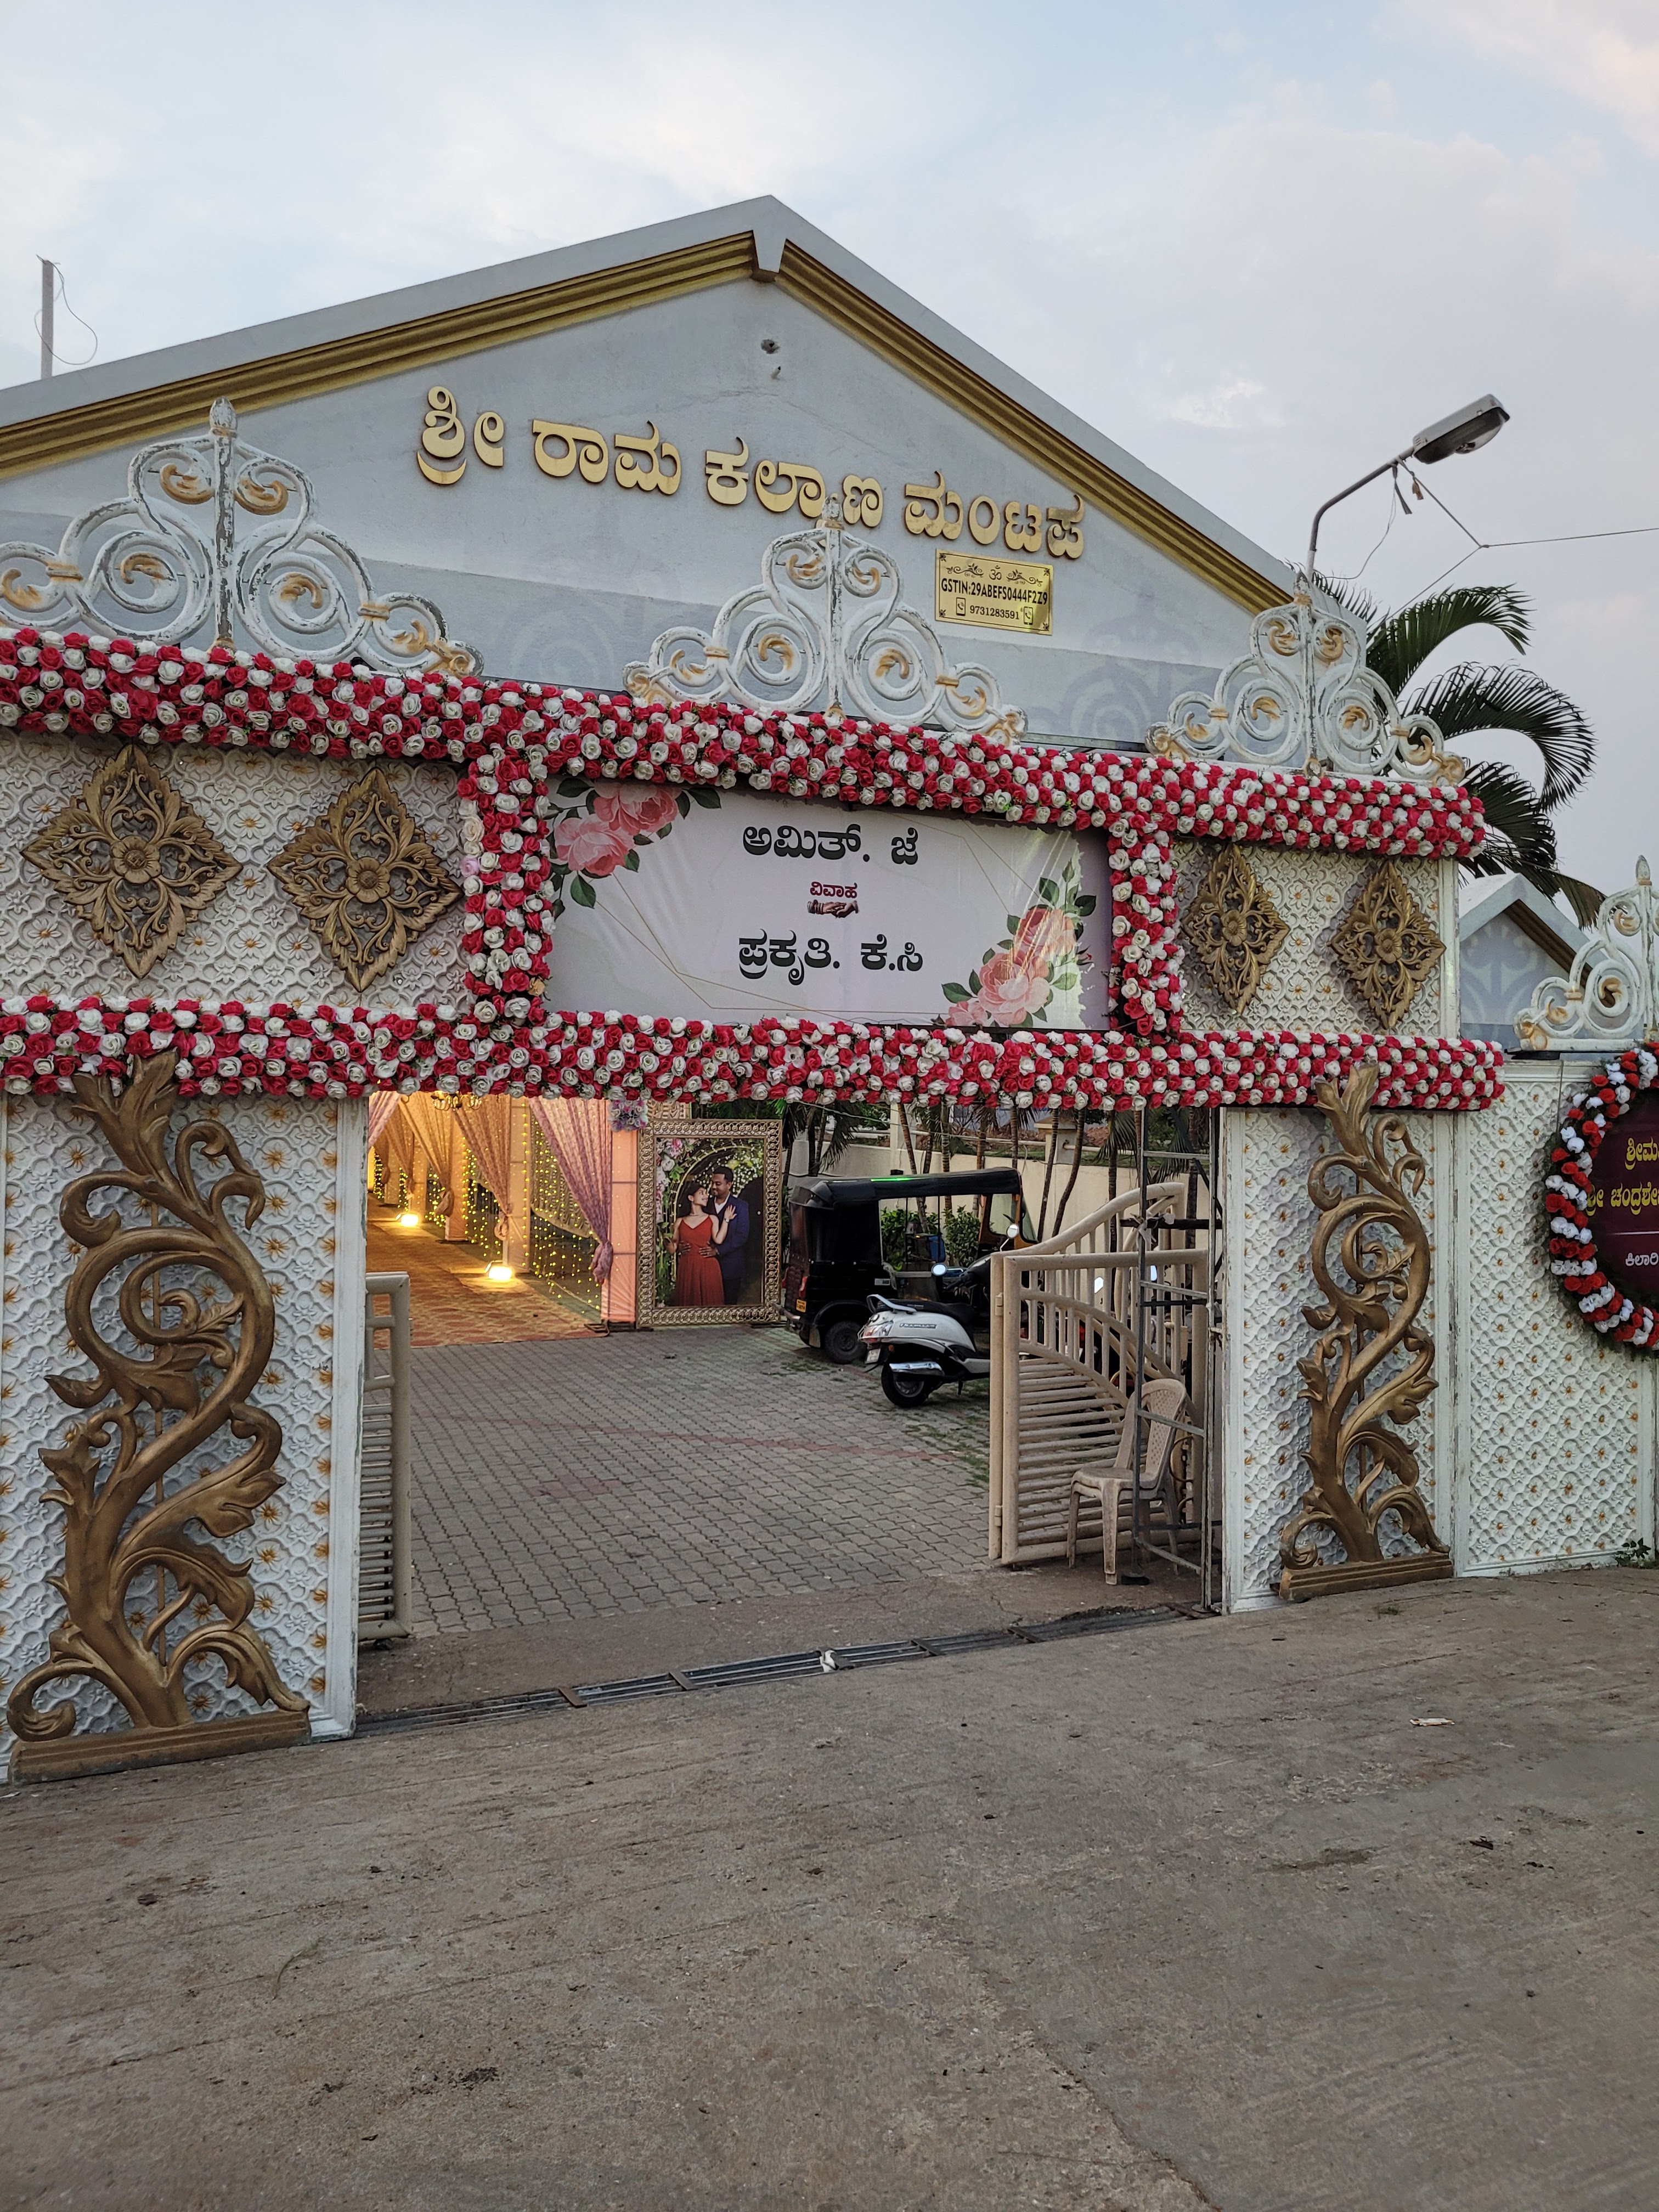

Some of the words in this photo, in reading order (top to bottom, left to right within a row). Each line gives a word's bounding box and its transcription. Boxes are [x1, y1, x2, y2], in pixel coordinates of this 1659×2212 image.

[416, 385, 504, 486] ಶ್ರೀ
[532, 419, 682, 495] ರಾಮ
[904, 470, 1085, 560] ಮಂಟಪ
[969, 605, 1020, 620] 9731283591
[742, 823, 871, 863] ಅಮಿತ್.
[890, 827, 919, 865] ಜೆ
[809, 881, 858, 899] ವಿವಾಹ
[738, 928, 840, 986] ಪ್ರಕೃತಿ.
[860, 933, 923, 972] ಕೆ.ಸಿ
[1624, 1136, 1659, 1170] ಶ್ರೀಮ
[1610, 1181, 1659, 1215] ಚಂದ್ರಶೇ
